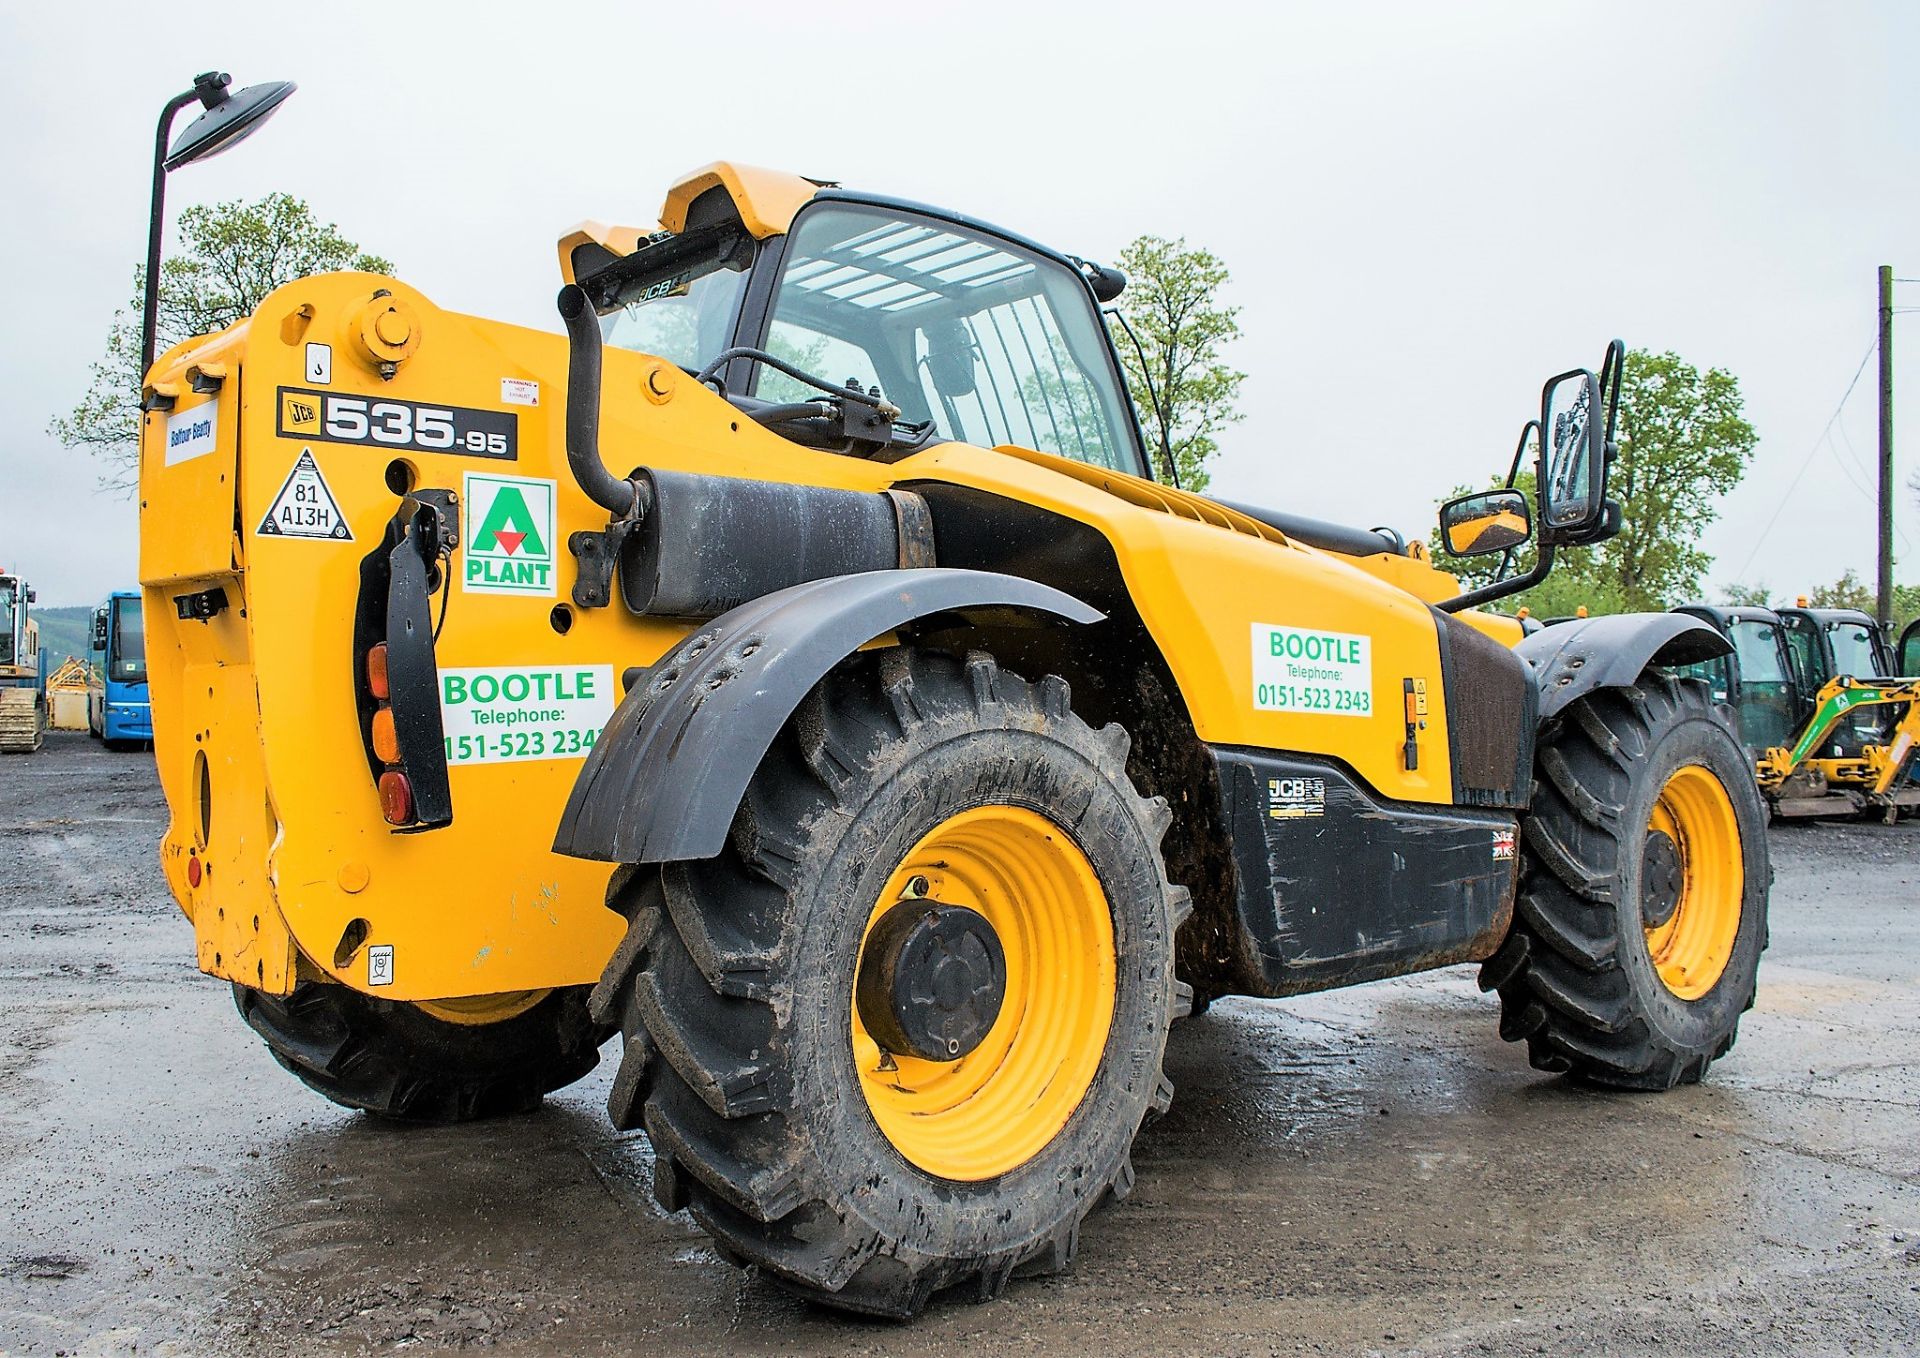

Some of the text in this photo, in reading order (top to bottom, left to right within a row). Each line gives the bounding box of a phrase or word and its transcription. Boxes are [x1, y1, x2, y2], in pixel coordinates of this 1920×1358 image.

[638, 279, 672, 303] JCB
[170, 419, 211, 447] Balfour Beatty
[292, 396, 508, 455] JCB 535-95
[295, 484, 318, 503] 81
[471, 486, 547, 556] A
[467, 559, 551, 586] PLANT
[1270, 632, 1361, 664] BOOTLE
[1286, 663, 1343, 681] Telephone:
[444, 672, 596, 705] BOOTLE
[1258, 683, 1370, 712] 0151-523 2343
[471, 709, 566, 727] Telephone:
[445, 727, 604, 760] 151-523 234
[1268, 779, 1306, 798] JCB
